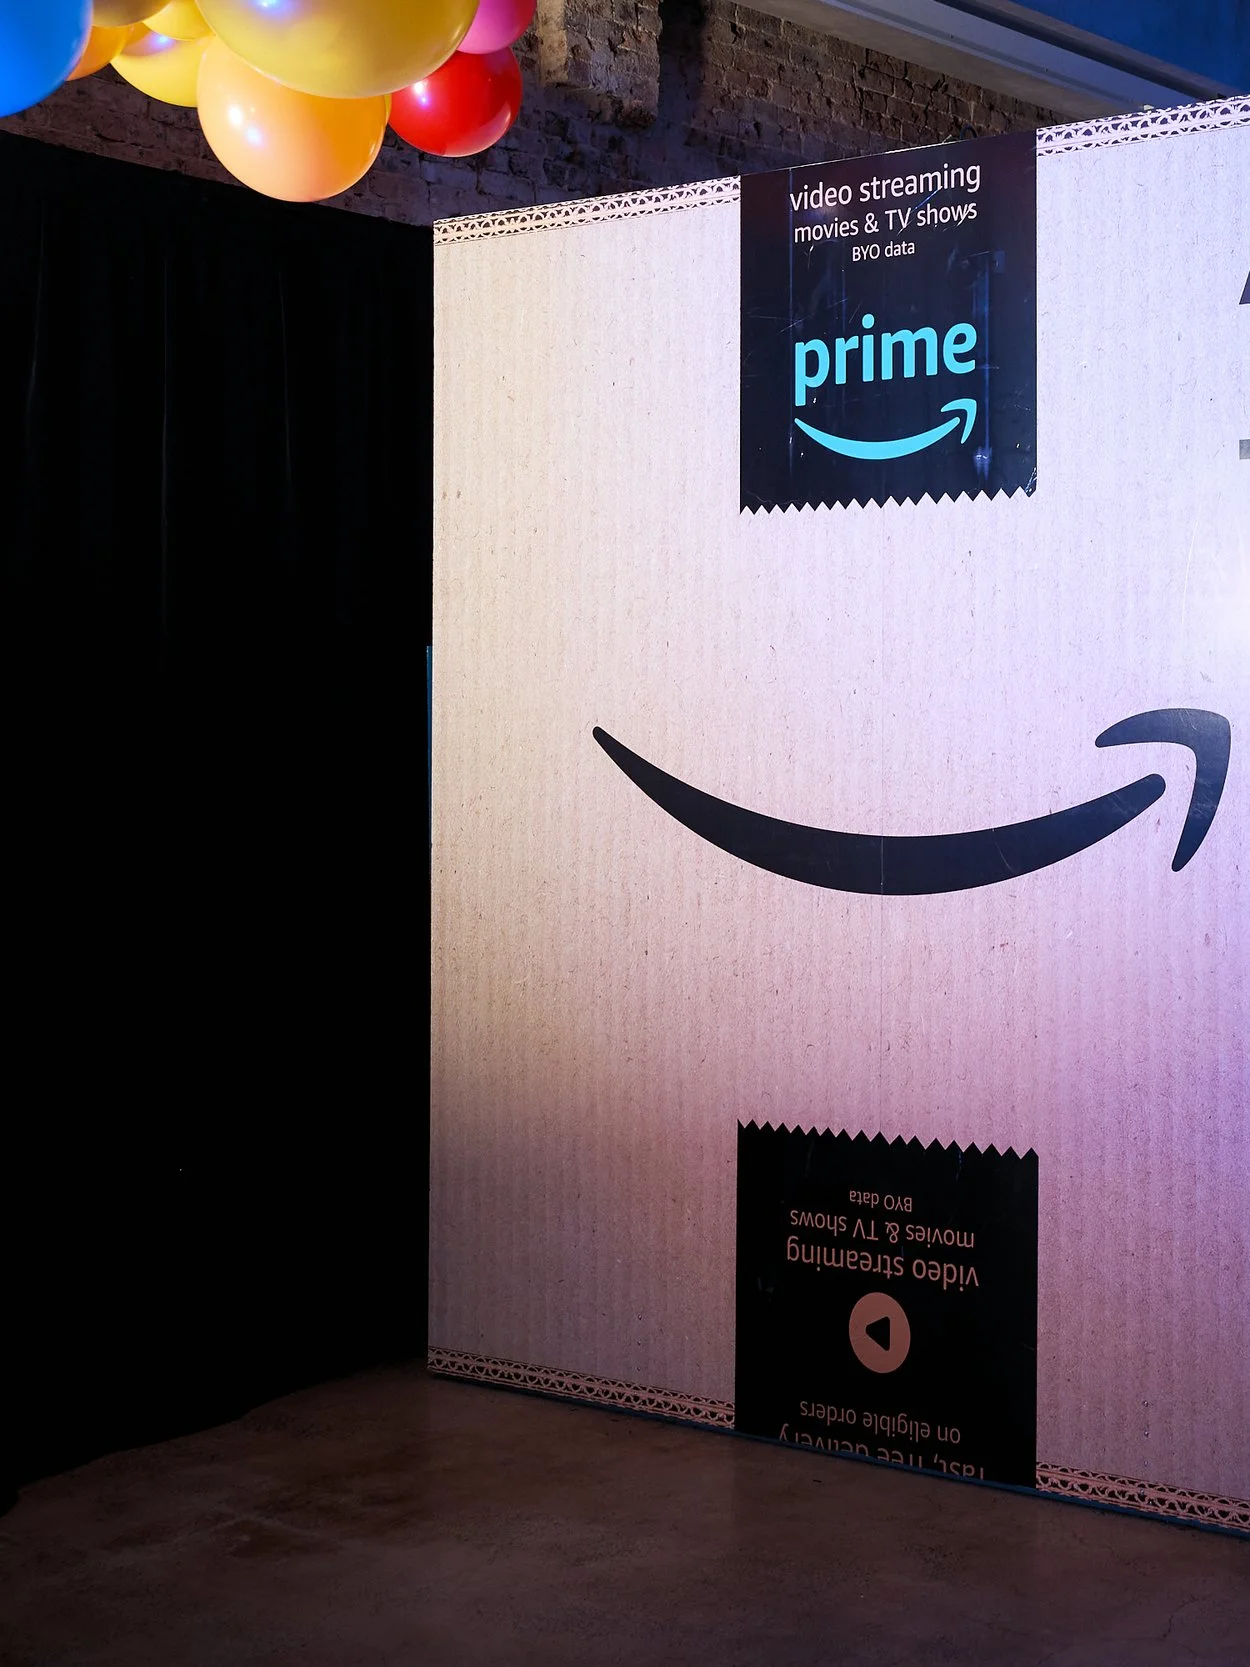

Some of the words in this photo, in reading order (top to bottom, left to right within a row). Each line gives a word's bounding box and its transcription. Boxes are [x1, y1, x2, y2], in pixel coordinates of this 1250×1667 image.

[789, 181, 853, 211] video
[859, 162, 981, 203] streaming
[794, 216, 859, 243] movies
[865, 212, 880, 234] &
[885, 207, 912, 231] TV
[917, 202, 978, 227] shows
[852, 243, 881, 262] BYO
[884, 240, 915, 258] data
[795, 313, 978, 407] prime
[849, 1190, 880, 1209] data
[883, 1194, 913, 1213] BYO
[790, 1209, 847, 1237] shows
[853, 1218, 879, 1241] TV
[885, 1221, 900, 1243] &
[905, 1223, 975, 1249] movies
[787, 1235, 904, 1279] streaming
[912, 1258, 979, 1292] video
[799, 1400, 857, 1426] orders
[861, 1411, 931, 1443] eligible
[937, 1425, 961, 1444] on
